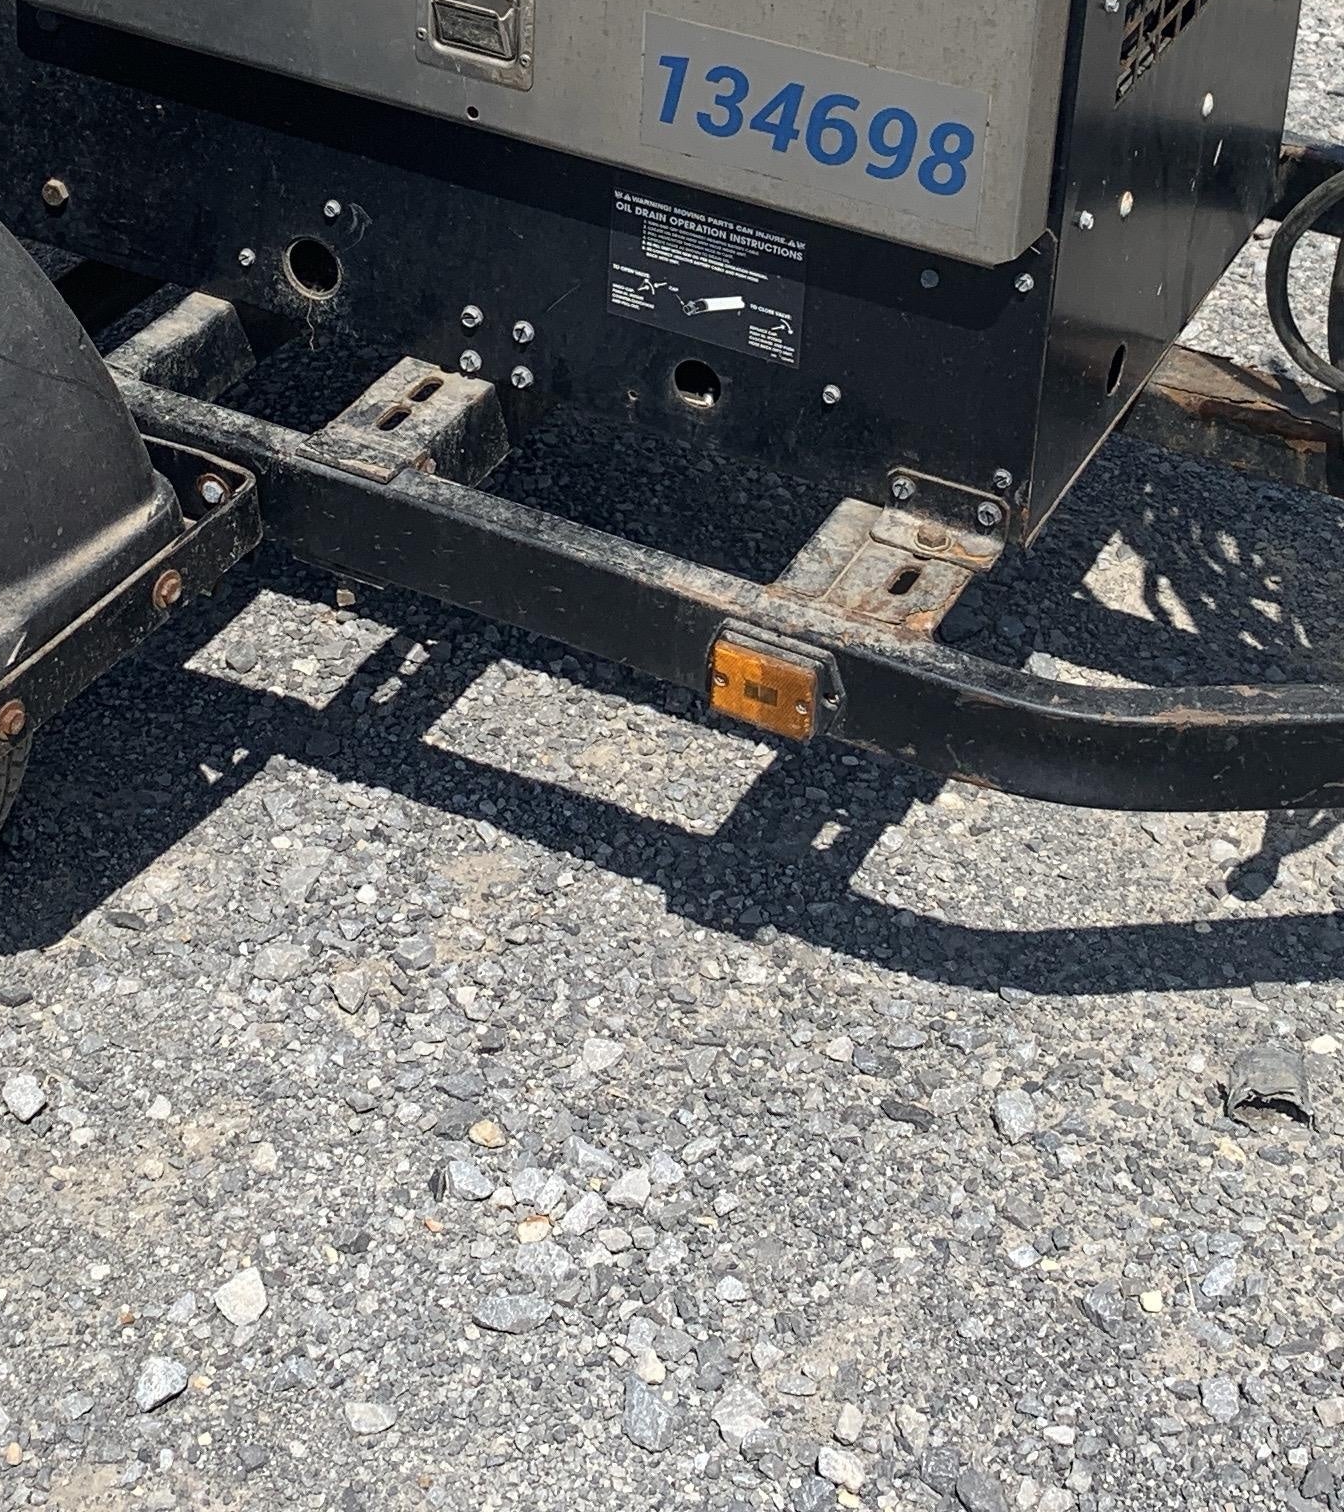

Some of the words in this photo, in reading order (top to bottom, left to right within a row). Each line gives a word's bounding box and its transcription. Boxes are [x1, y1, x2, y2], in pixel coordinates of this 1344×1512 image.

[658, 54, 975, 197] 134698
[615, 201, 633, 214] OIL
[635, 206, 667, 223] DRAIN
[669, 215, 727, 240] OPERATION
[729, 231, 804, 262] INSTRUCTIONS
[673, 207, 706, 223] MOVING
[707, 216, 734, 230] PARTS
[736, 225, 754, 236] CAN
